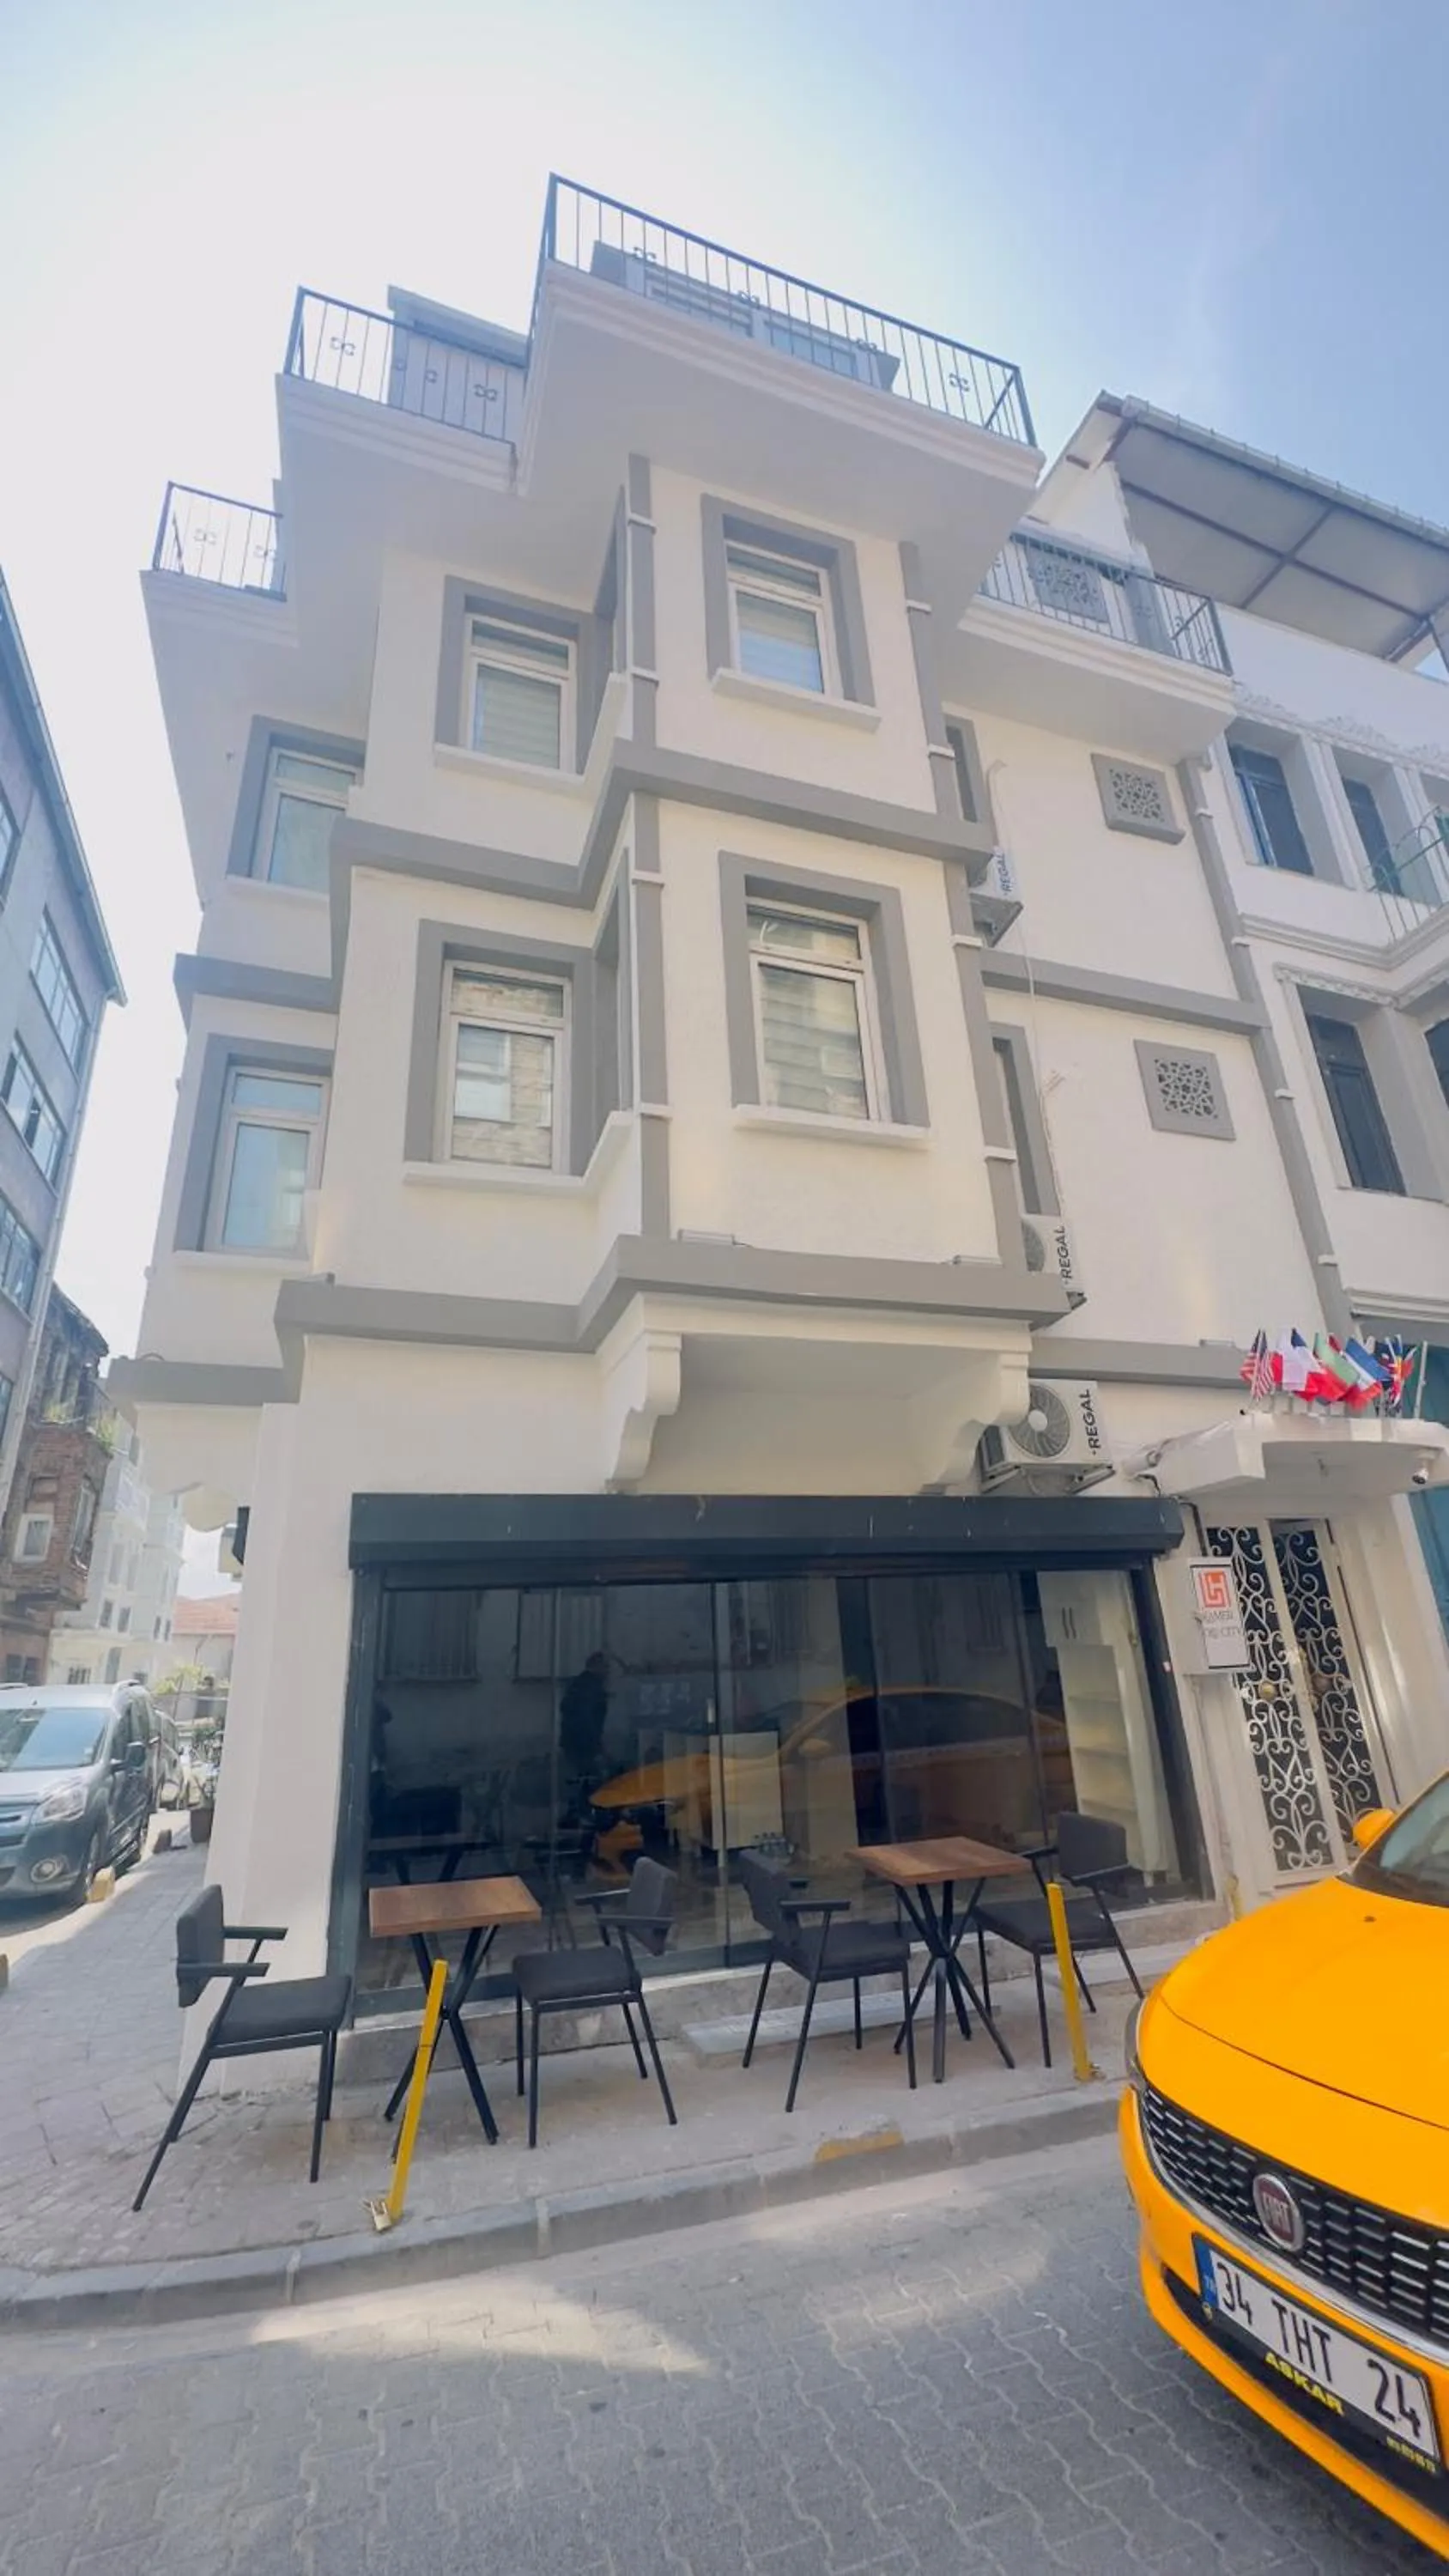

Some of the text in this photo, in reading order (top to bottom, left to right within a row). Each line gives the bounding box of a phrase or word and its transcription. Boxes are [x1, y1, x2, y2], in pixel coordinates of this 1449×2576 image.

[1054, 1225, 1073, 1279] REGAL
[1079, 1388, 1101, 1449] REGAL
[1217, 2262, 1422, 2439] 34 THT 24
